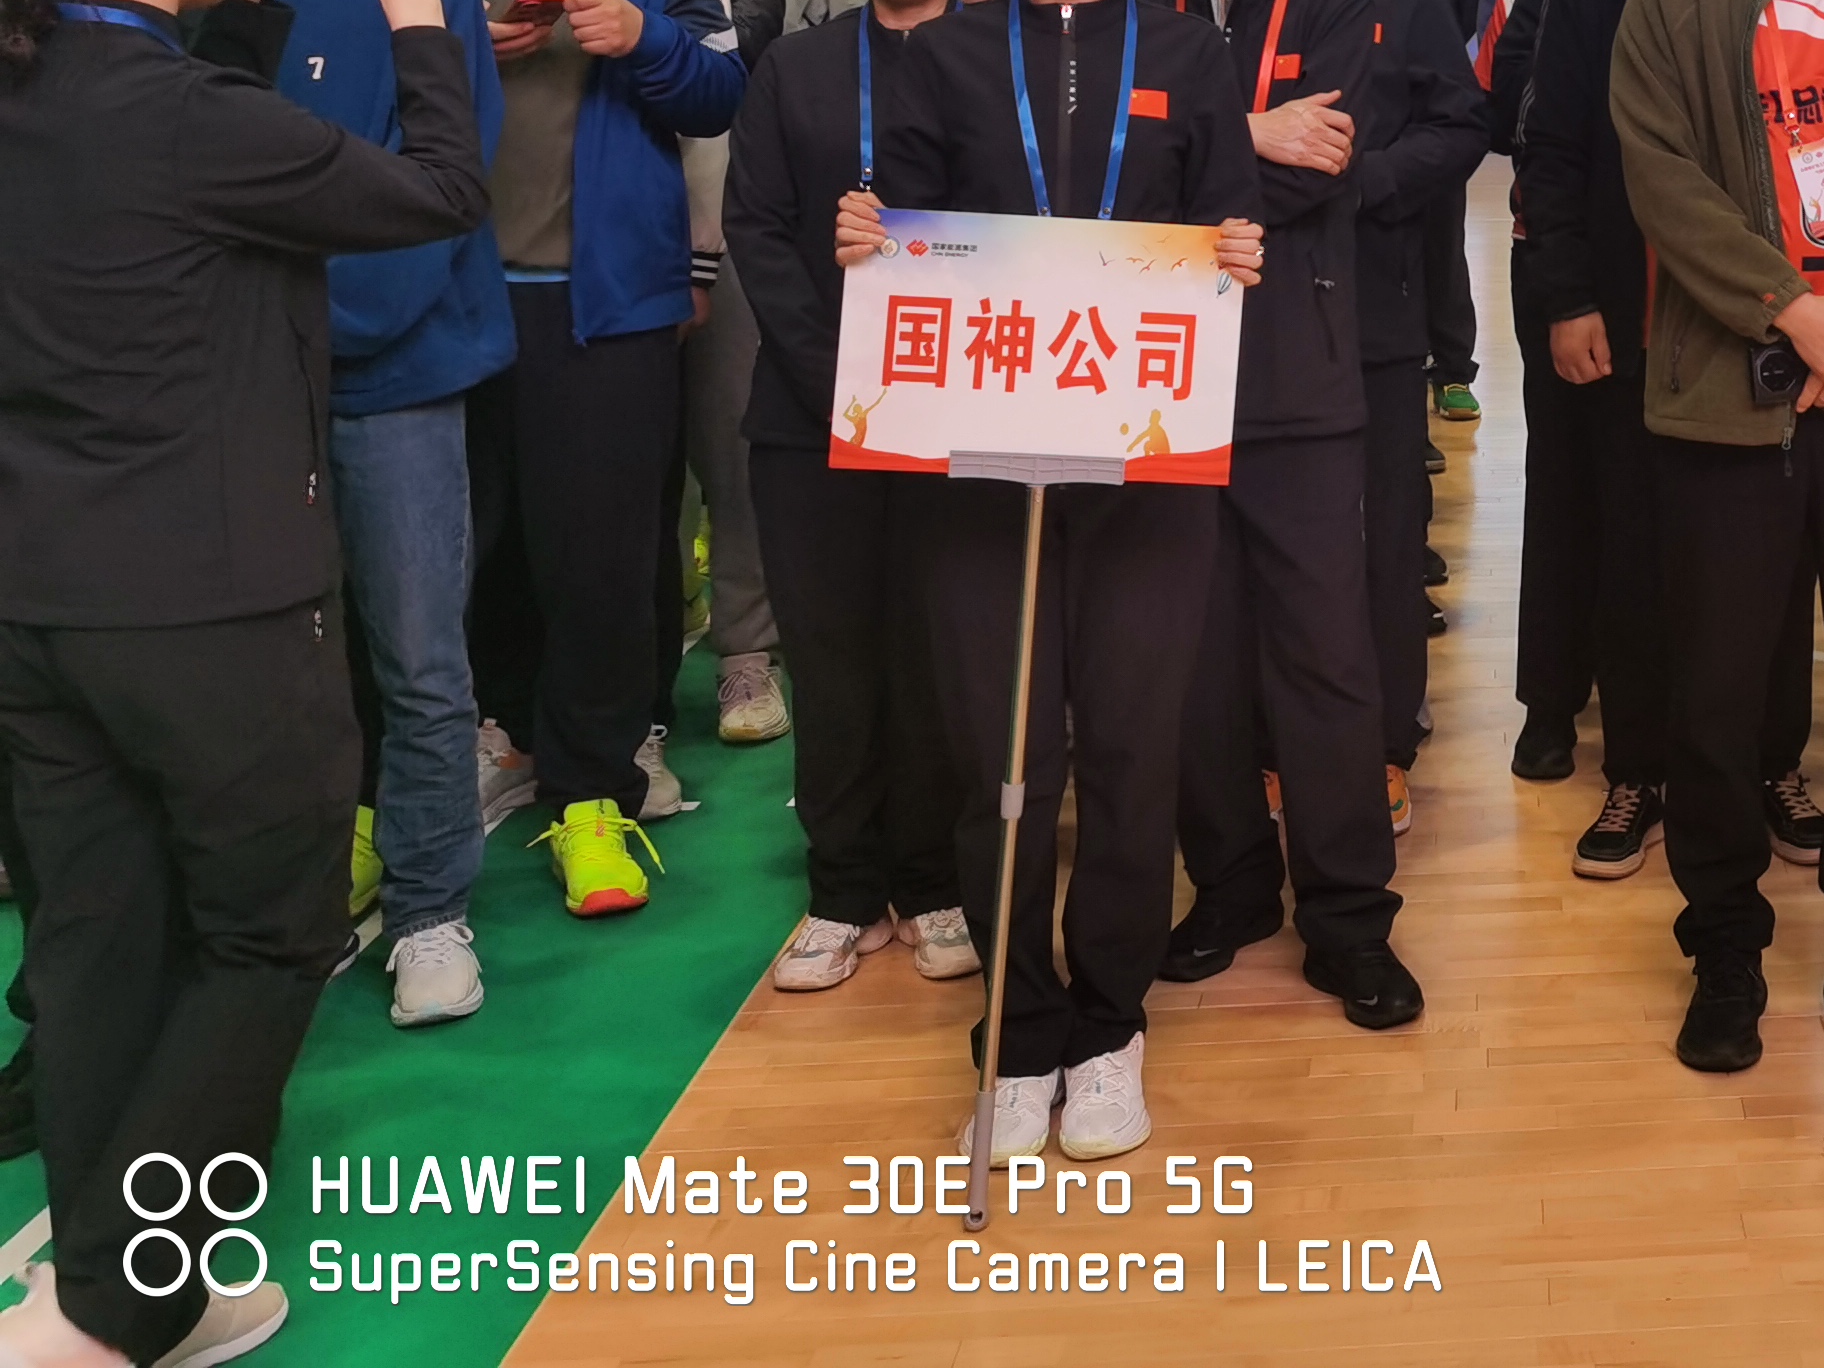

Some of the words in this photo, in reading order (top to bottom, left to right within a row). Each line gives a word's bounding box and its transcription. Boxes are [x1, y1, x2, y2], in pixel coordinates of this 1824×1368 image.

[307, 56, 325, 80] 7
[881, 294, 1197, 400] 国神公司
